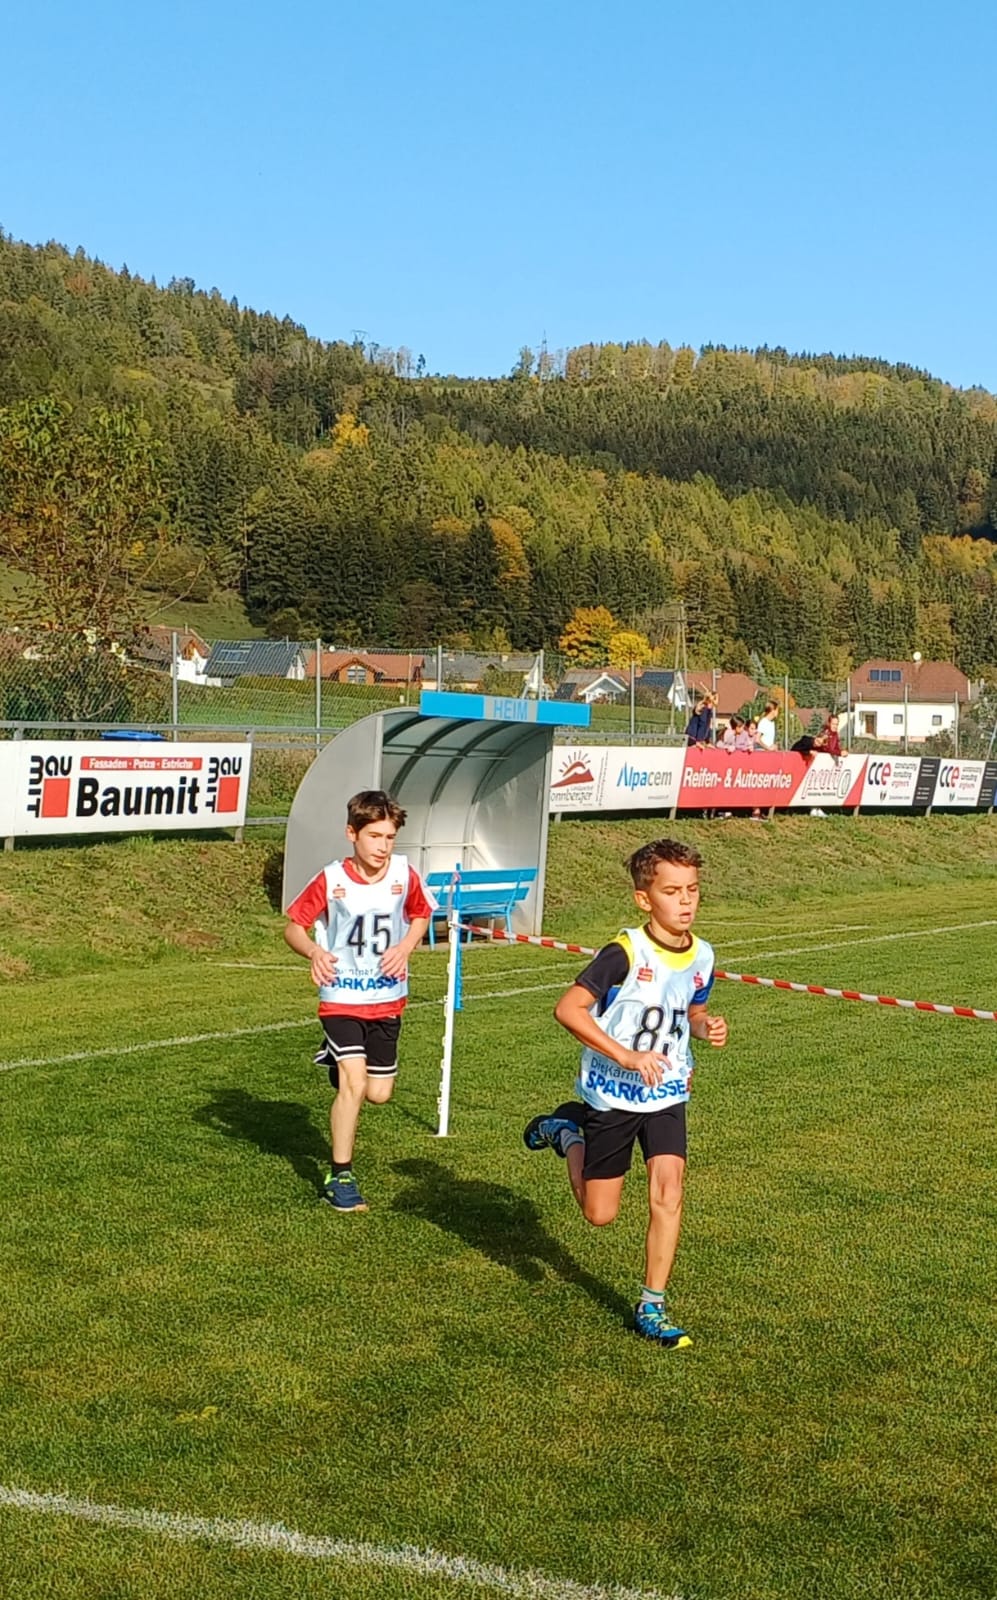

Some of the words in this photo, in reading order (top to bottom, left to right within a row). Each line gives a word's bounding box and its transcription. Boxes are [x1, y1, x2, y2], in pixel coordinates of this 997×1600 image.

[493, 699, 528, 721] HEIM
[89, 758, 128, 769] Fassaden
[616, 762, 672, 791] Alpacem
[683, 768, 721, 788] Reifen-
[724, 768, 731, 788] &
[733, 768, 792, 788] Autoservice
[76, 776, 200, 817] Baumit
[347, 914, 391, 956] 45
[633, 1006, 687, 1056] 85
[586, 1071, 687, 1103] SPARKASSE
